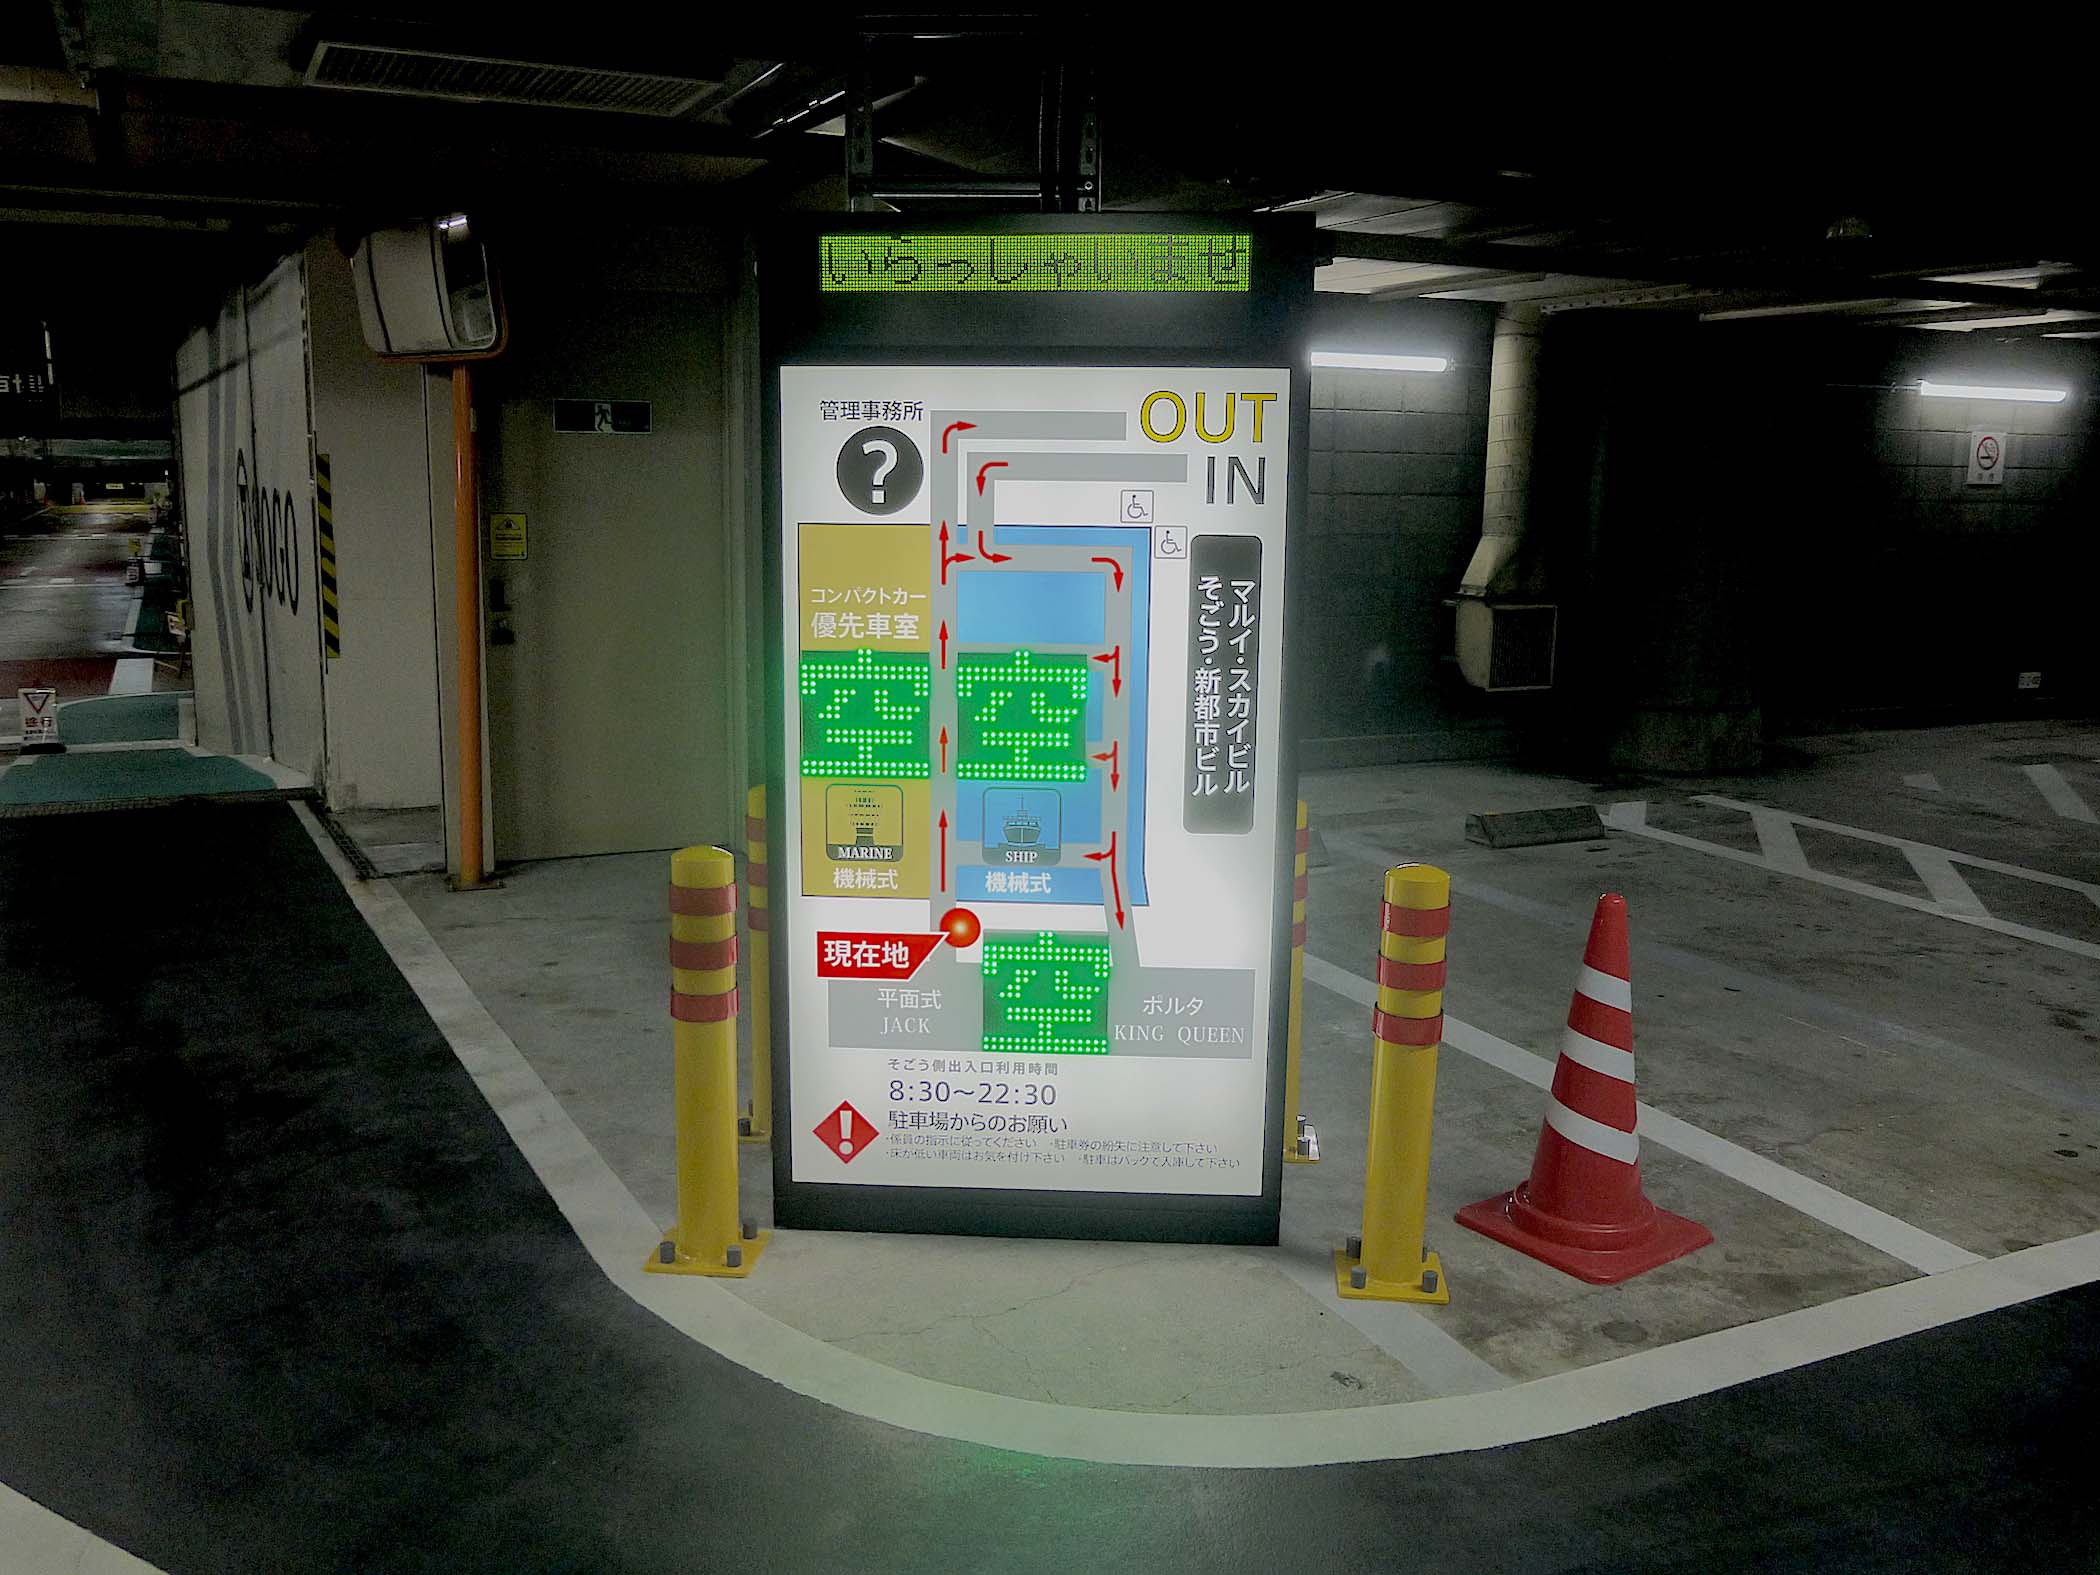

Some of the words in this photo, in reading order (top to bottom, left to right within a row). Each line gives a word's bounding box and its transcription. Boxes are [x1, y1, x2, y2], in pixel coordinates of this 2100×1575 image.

[827, 234, 1248, 287] いらっしゃいませ
[819, 400, 924, 422] 管理事務所
[1140, 391, 1277, 443] OUT
[1205, 456, 1266, 505] IN
[810, 586, 927, 606] コンパクトカー
[810, 612, 920, 641] 優先車室
[1192, 575, 1225, 797] そごう・新都市ビル
[1224, 579, 1256, 795] マルイ・スカイビル
[800, 648, 930, 779] 空
[957, 650, 1089, 781] 空
[837, 847, 894, 861] MARINE
[1005, 850, 1039, 864] SHIP
[833, 867, 899, 890] 機械式
[985, 871, 1052, 894] 機械式
[823, 940, 911, 969] 現在地
[876, 987, 943, 1010] 平面式
[982, 931, 1112, 1055] 空
[1142, 995, 1206, 1017] ポルタ
[879, 1015, 931, 1035] JACK
[1113, 1023, 1166, 1044] KING
[1178, 1025, 1246, 1046] QUEEN
[887, 1058, 1059, 1076] そごう側出入口利用時間
[888, 1111, 1068, 1134] 駐車場からのお願い
